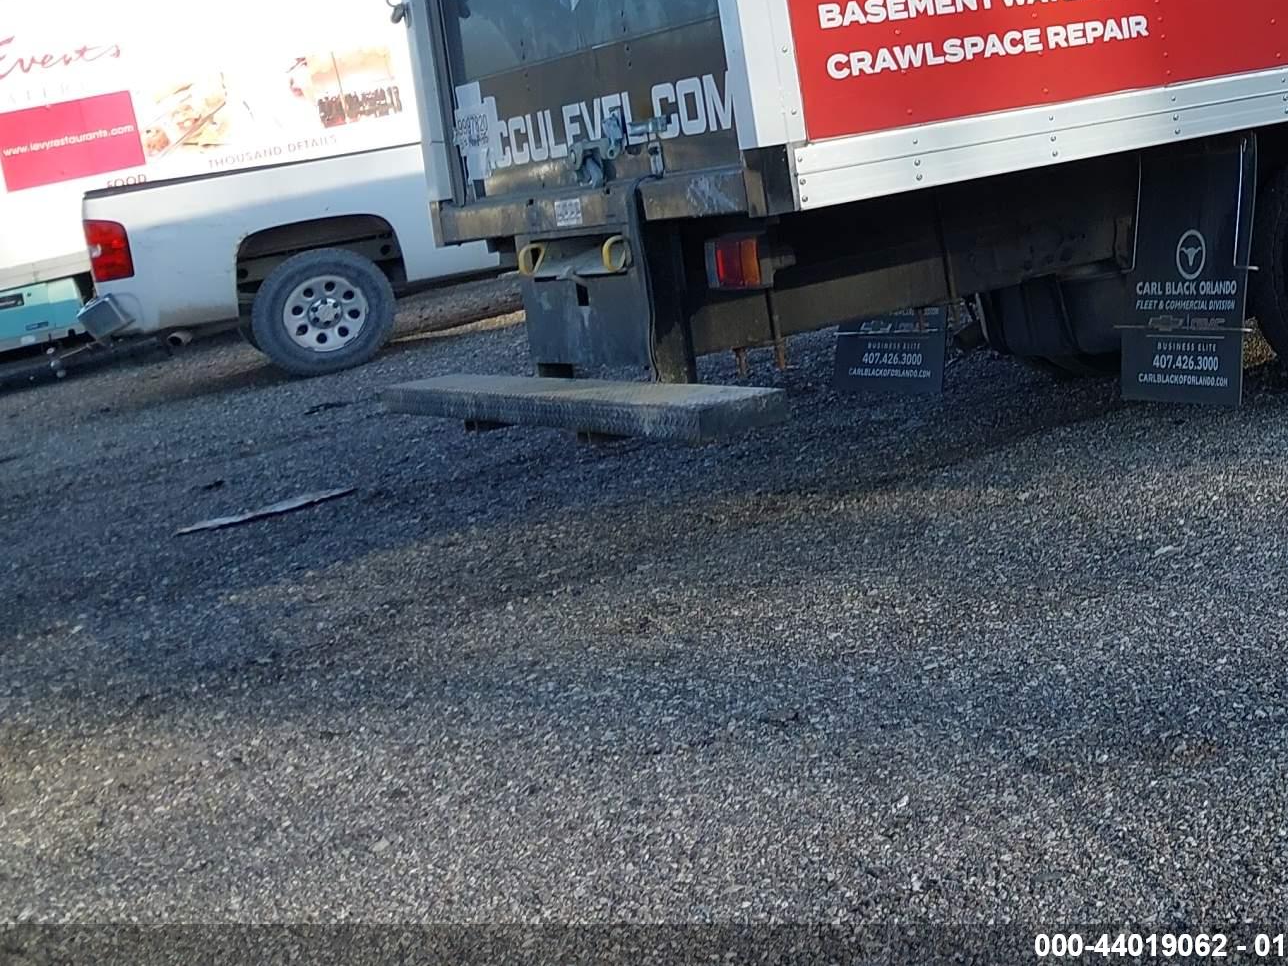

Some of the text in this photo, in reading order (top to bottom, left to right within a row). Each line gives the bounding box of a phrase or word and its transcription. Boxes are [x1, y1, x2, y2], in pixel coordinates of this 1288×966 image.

[826, 15, 1150, 81] CRAWLSPACE REPAIR
[3, 123, 135, 157] www.levyrestaurants.com
[1136, 280, 1237, 295] CARL BLACK ORLANDO
[1136, 299, 1159, 310] FLEET
[1165, 300, 1208, 310] COMMERCIAL
[1208, 300, 1235, 310] DIVISION
[1157, 342, 1217, 352] BUSINESS ELITE
[862, 353, 923, 365] 407.426.3000
[1152, 354, 1219, 371] 407.426.3000
[1138, 373, 1228, 387] CARLBLACKOFORLANDO.COM
